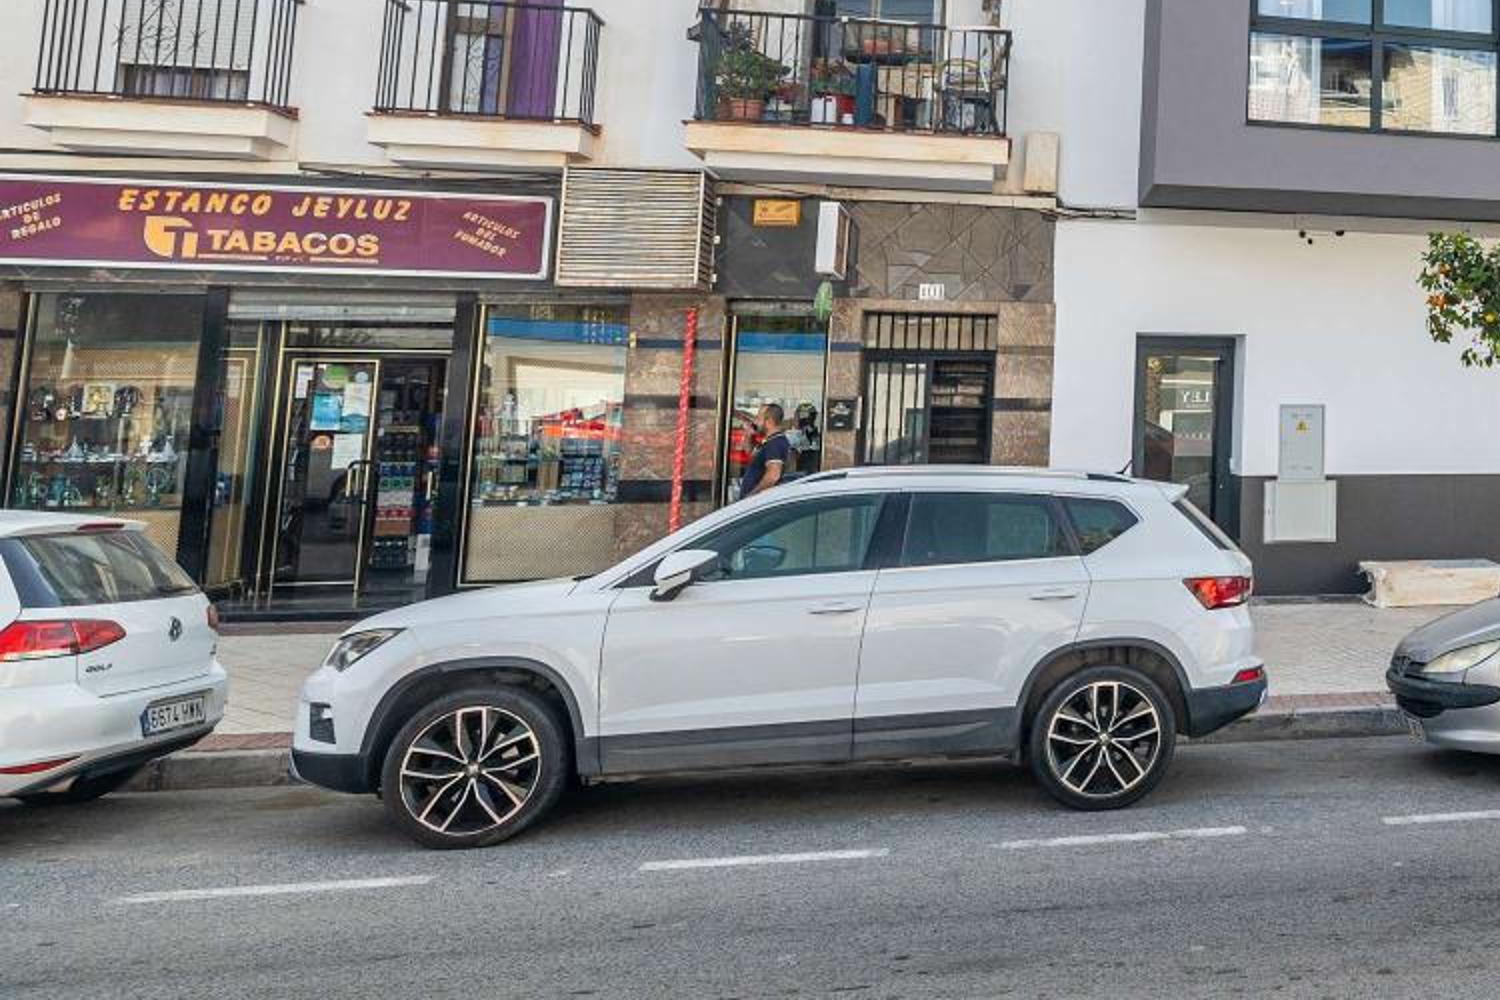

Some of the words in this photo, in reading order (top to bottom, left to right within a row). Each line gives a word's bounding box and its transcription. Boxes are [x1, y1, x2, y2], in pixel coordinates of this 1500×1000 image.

[0, 193, 61, 220] RTICULOS
[118, 188, 273, 215] ESTANCO
[291, 196, 412, 221] JEYLUZ
[11, 216, 61, 239] REGALO
[463, 211, 520, 239] ARTICULOS
[206, 229, 380, 256] TABACOS
